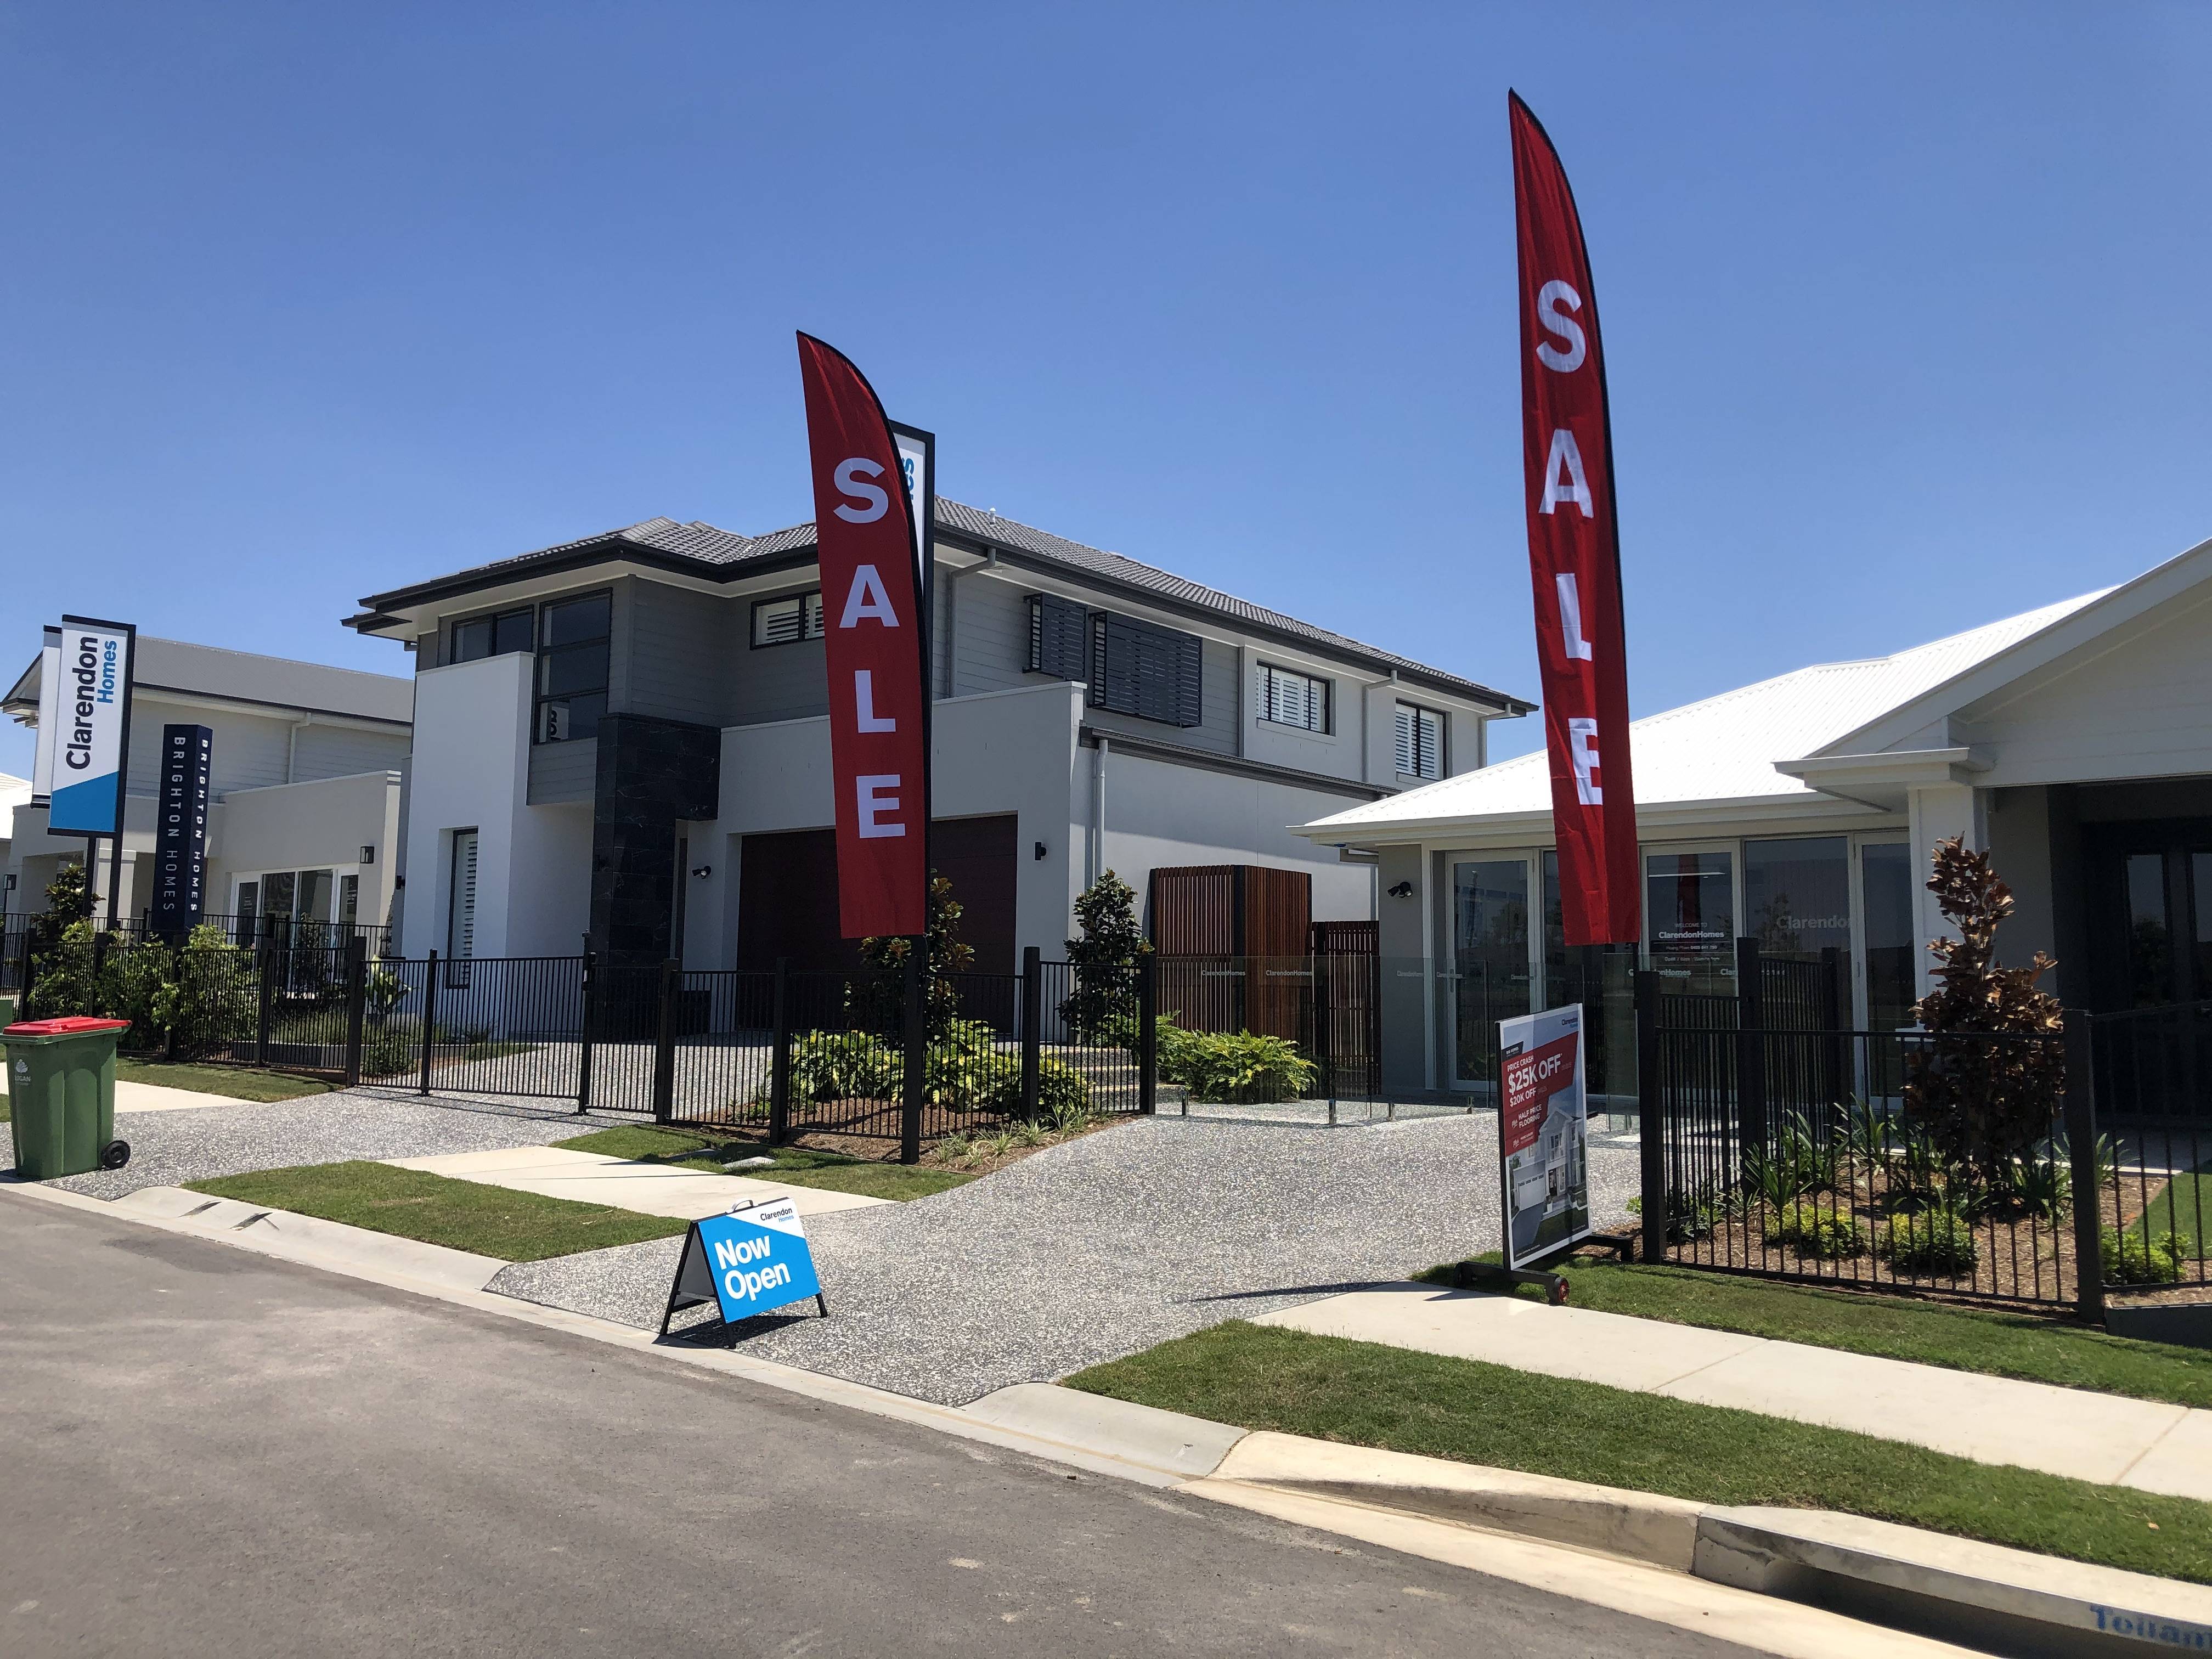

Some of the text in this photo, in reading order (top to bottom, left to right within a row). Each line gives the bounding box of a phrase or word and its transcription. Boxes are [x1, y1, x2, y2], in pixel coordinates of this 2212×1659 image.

[1536, 279, 1603, 805] SALE
[833, 457, 906, 839] SALE
[97, 640, 117, 703] Homes
[66, 636, 98, 769] Clarendon
[163, 737, 186, 910] BRIGHTON HOMES
[191, 740, 208, 911] BRIGHTON HOMES
[1658, 930, 1724, 939] ClarendonHomes
[1507, 1055, 1534, 1072] PRICE CRASH
[1508, 1064, 1538, 1096] $25K
[1509, 1091, 1524, 1108] $20K
[1518, 1104, 1542, 1120] HALF PRICE
[1519, 1113, 1541, 1128] FLOORING
[760, 1206, 793, 1221] Clarendon
[778, 1214, 794, 1223] Homes
[714, 1235, 771, 1270] Now
[724, 1262, 791, 1302] Open
